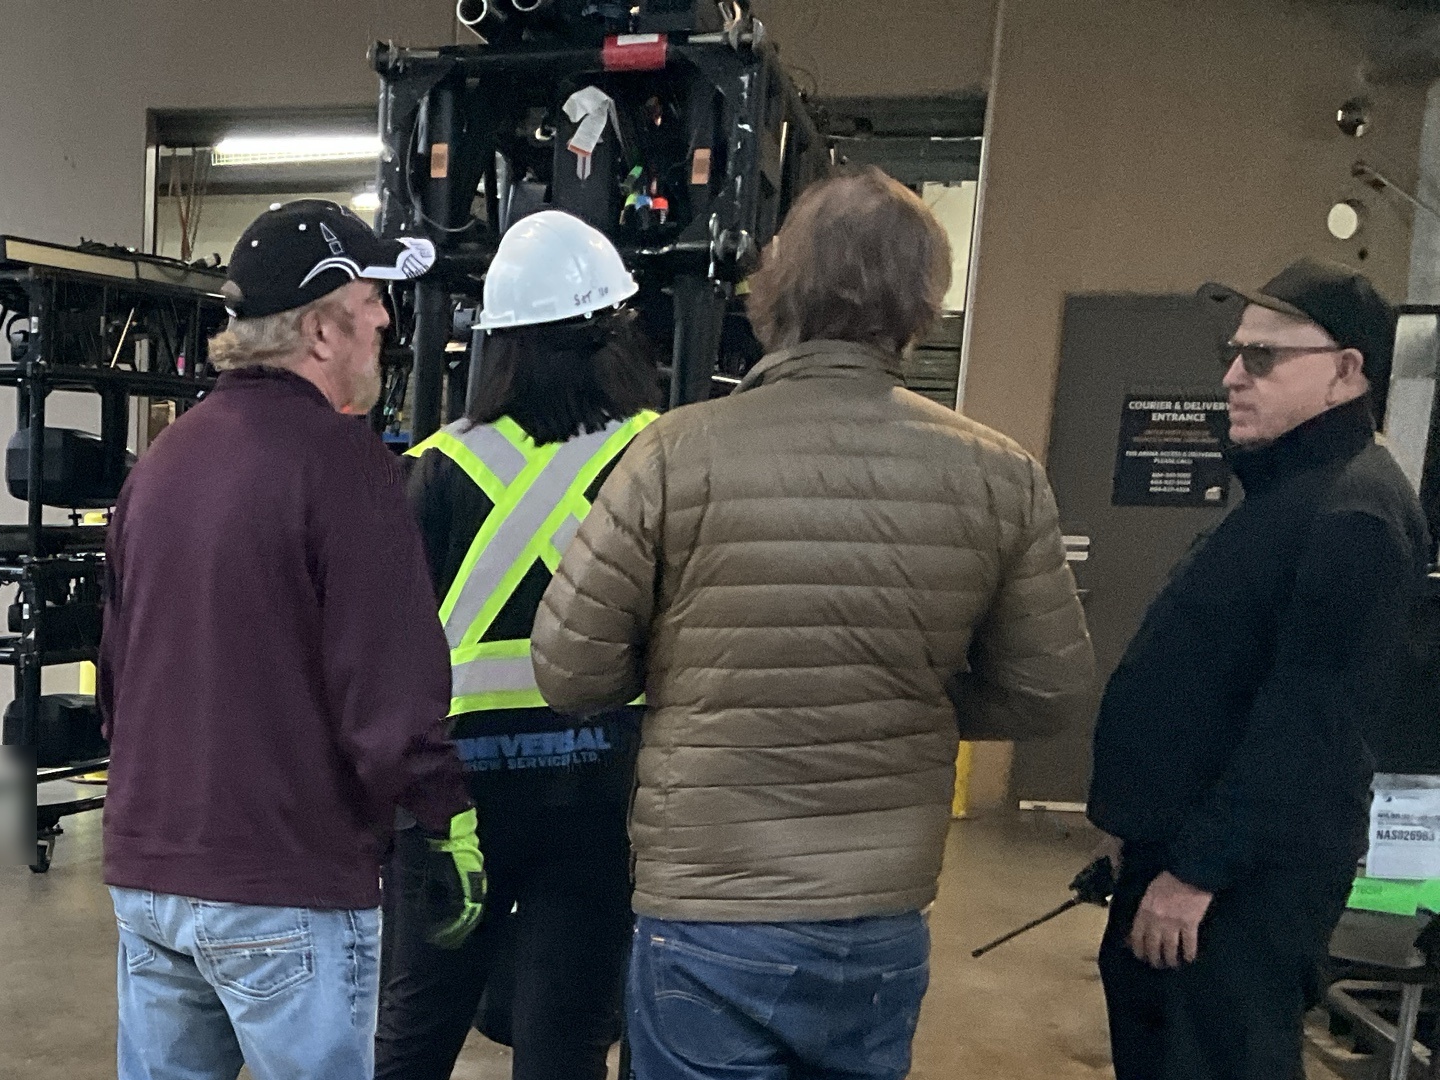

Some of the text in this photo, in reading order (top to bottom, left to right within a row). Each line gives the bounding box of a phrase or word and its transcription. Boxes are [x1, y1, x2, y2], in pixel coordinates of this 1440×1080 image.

[1128, 401, 1172, 410] COURIER
[1174, 401, 1181, 410] &
[1151, 412, 1206, 421] ENTRANCE
